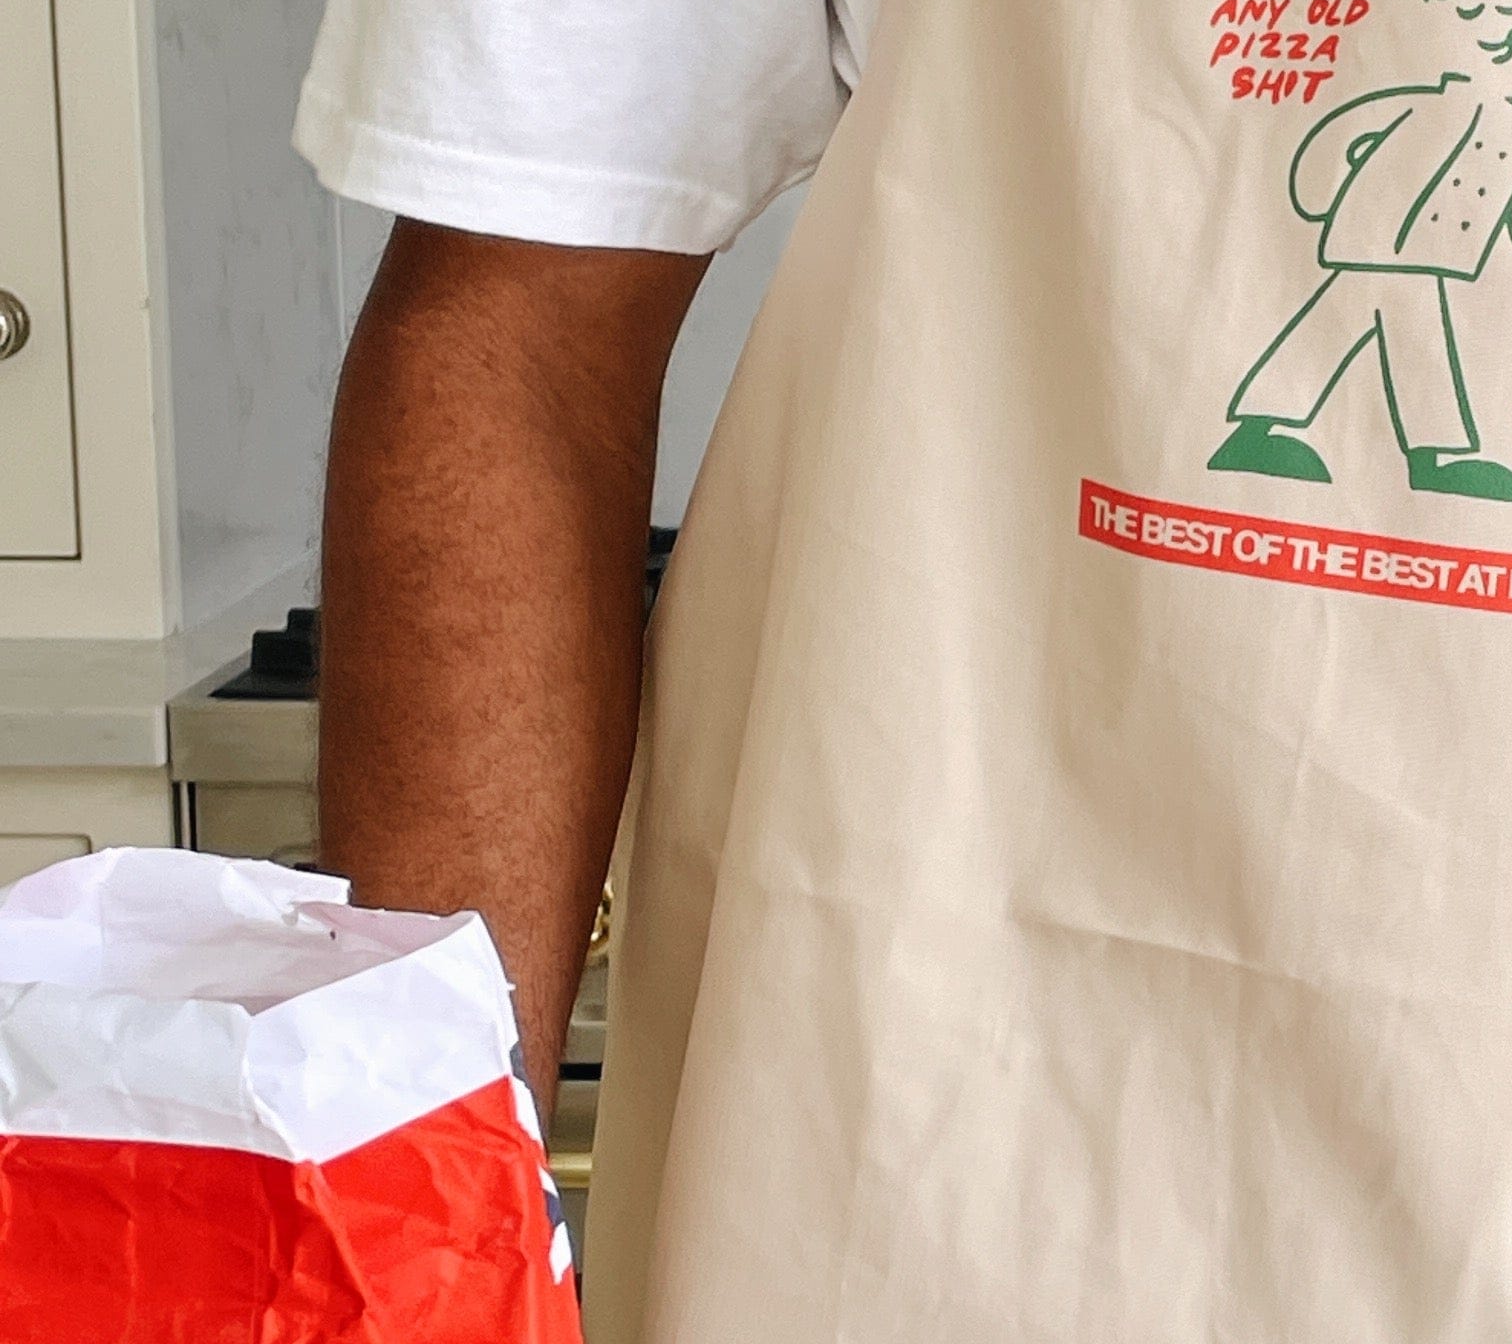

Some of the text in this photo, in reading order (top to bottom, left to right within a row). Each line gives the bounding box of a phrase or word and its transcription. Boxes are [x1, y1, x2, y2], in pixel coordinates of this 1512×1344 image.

[1209, 31, 1340, 68] PIZZA
[1231, 66, 1335, 105] SHIT
[1090, 495, 1139, 541] THE
[1140, 512, 1232, 558] BEST
[1231, 527, 1287, 566] OF
[1286, 537, 1359, 578] THE
[1361, 548, 1458, 592] BEST
[1456, 562, 1507, 597] AT
